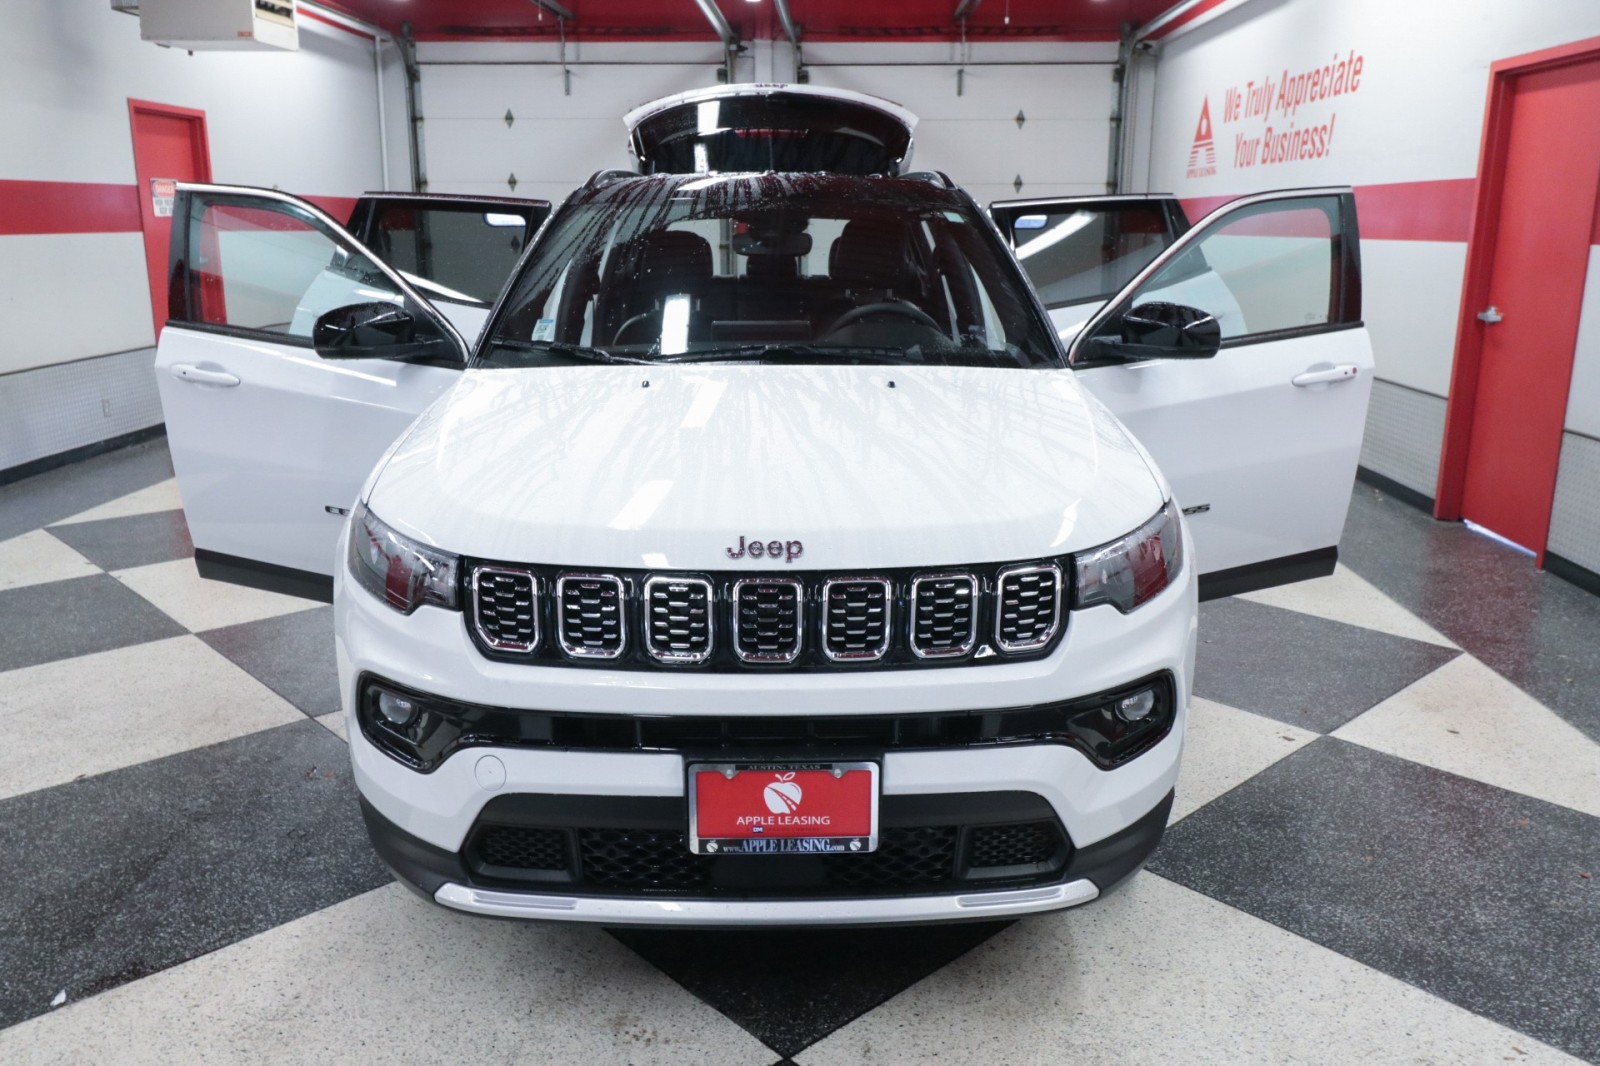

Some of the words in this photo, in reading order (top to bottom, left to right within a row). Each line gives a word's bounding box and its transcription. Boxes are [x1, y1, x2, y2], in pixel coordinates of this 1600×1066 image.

[1224, 87, 1241, 123] We
[1245, 75, 1276, 122] Truly
[1275, 49, 1363, 118] Appreciate
[1233, 132, 1261, 168] Your
[1261, 112, 1336, 165] Business!
[726, 535, 804, 563] Jeep
[736, 816, 775, 825] APPLE
[778, 816, 831, 825] LEASING
